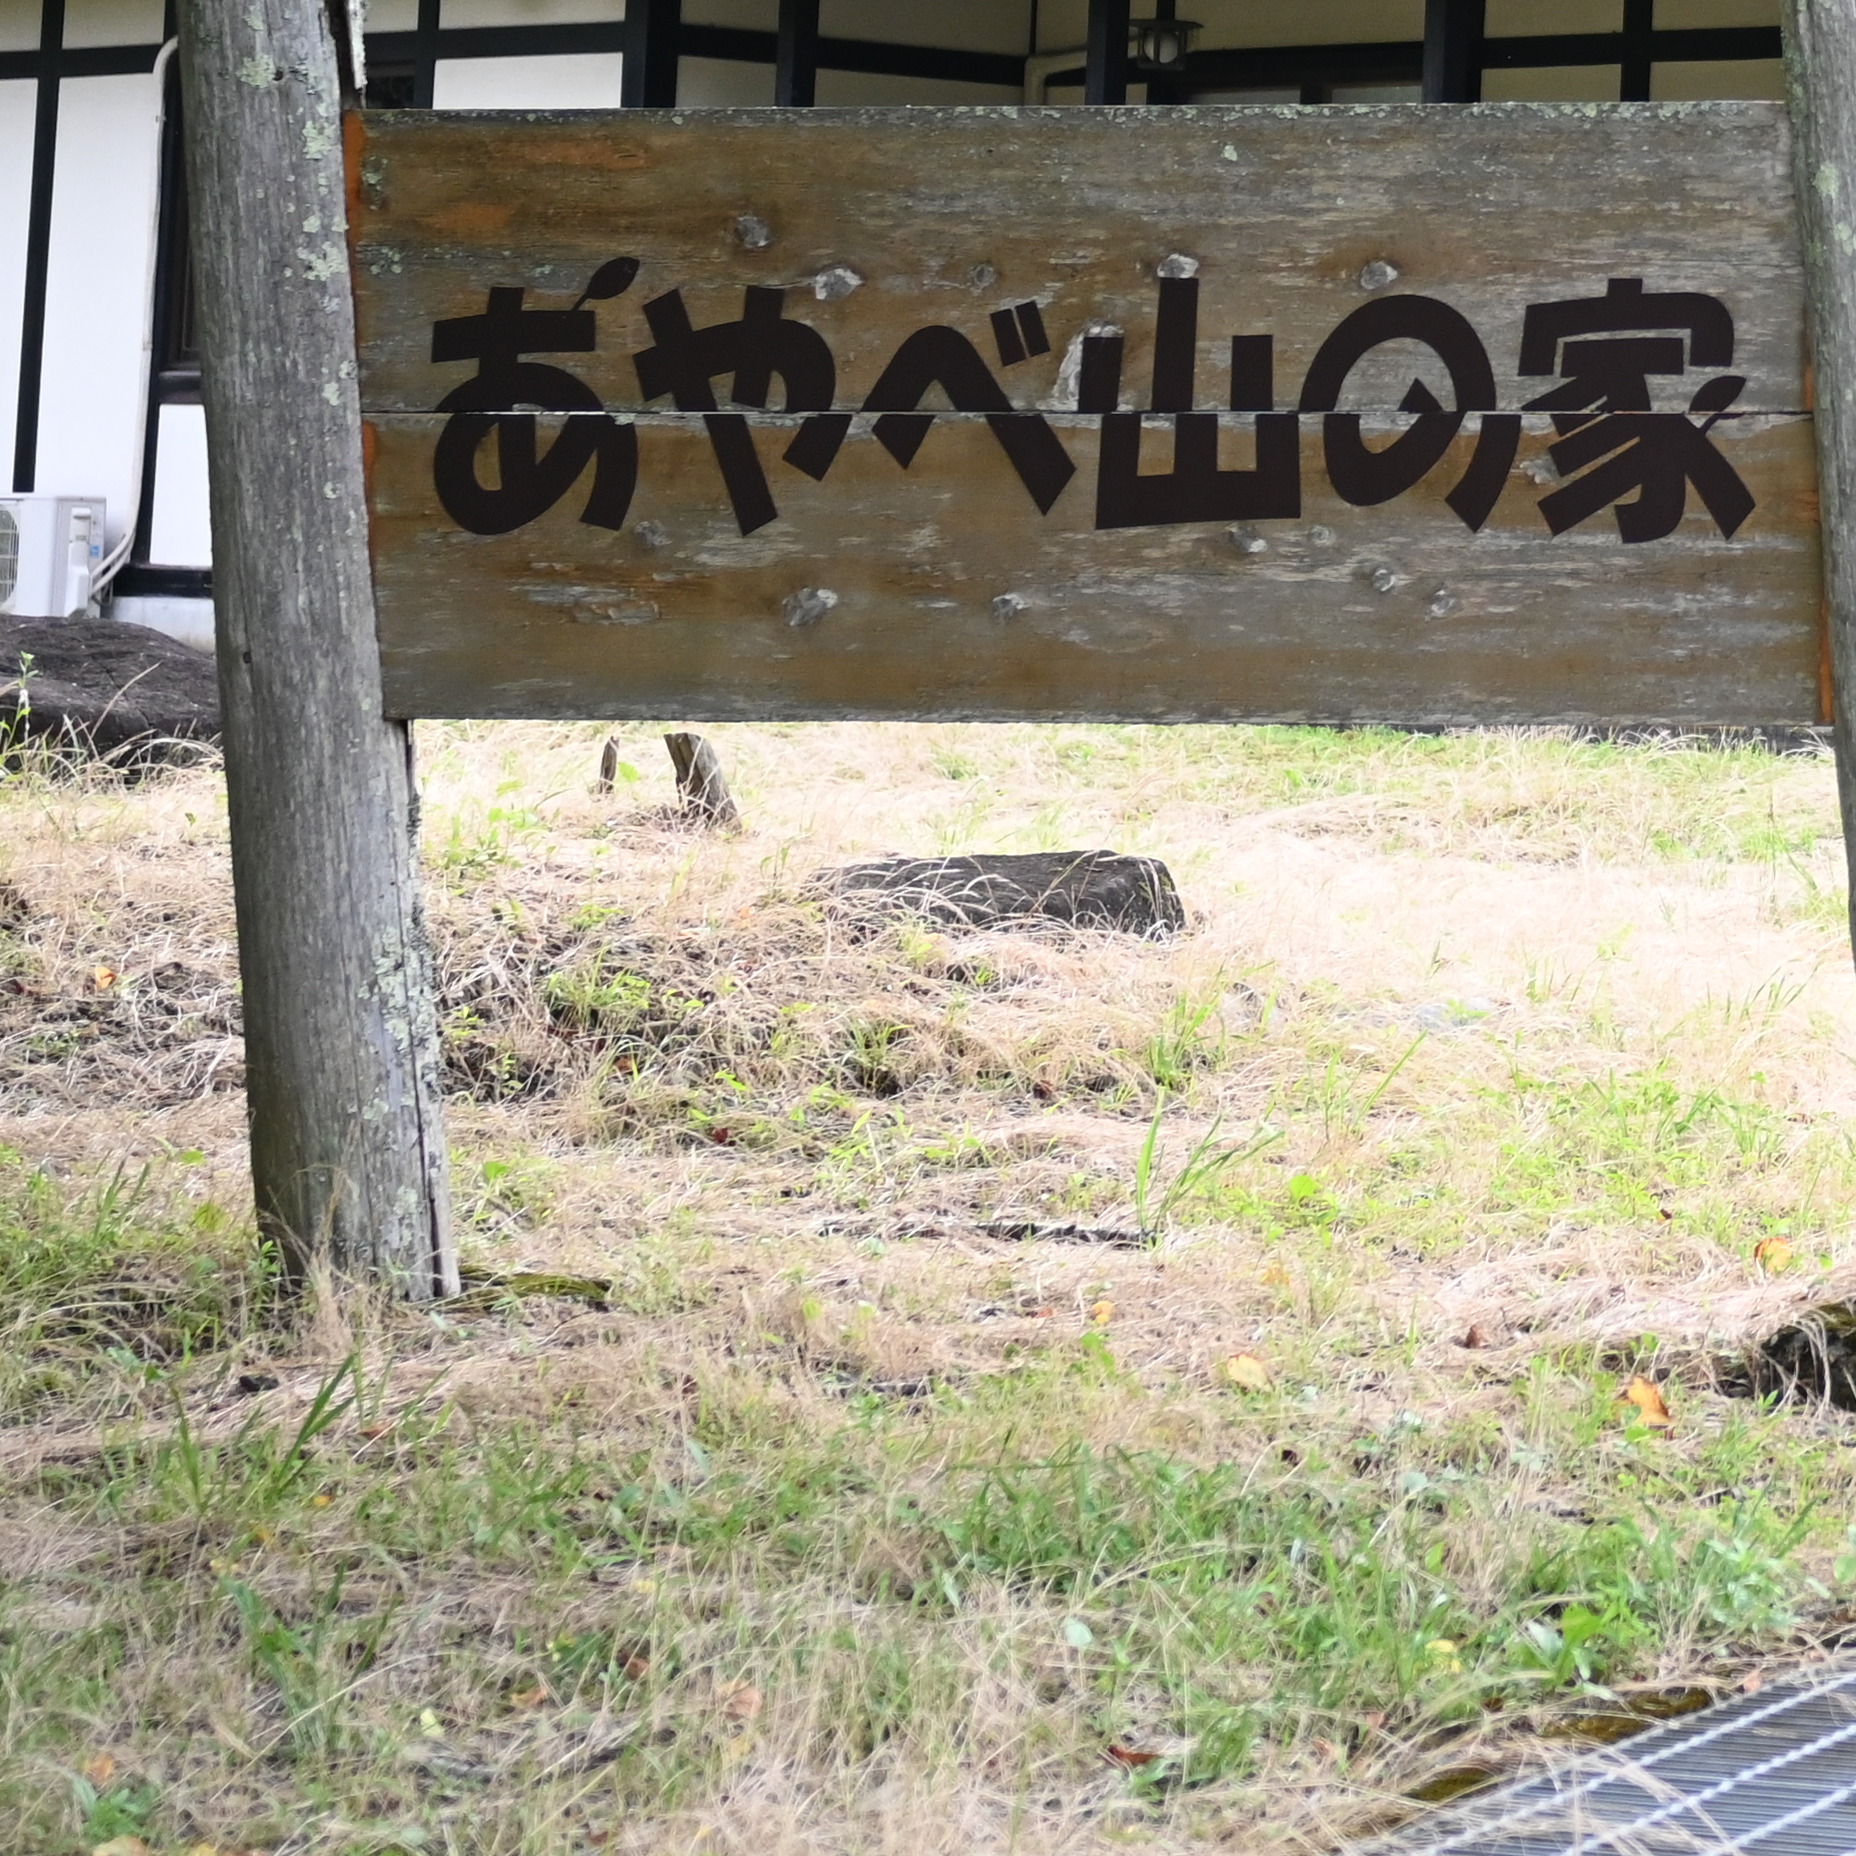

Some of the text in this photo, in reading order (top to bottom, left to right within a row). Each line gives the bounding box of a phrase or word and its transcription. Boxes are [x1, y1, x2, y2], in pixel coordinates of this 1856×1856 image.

[431, 255, 1757, 543] あやべ山の家
